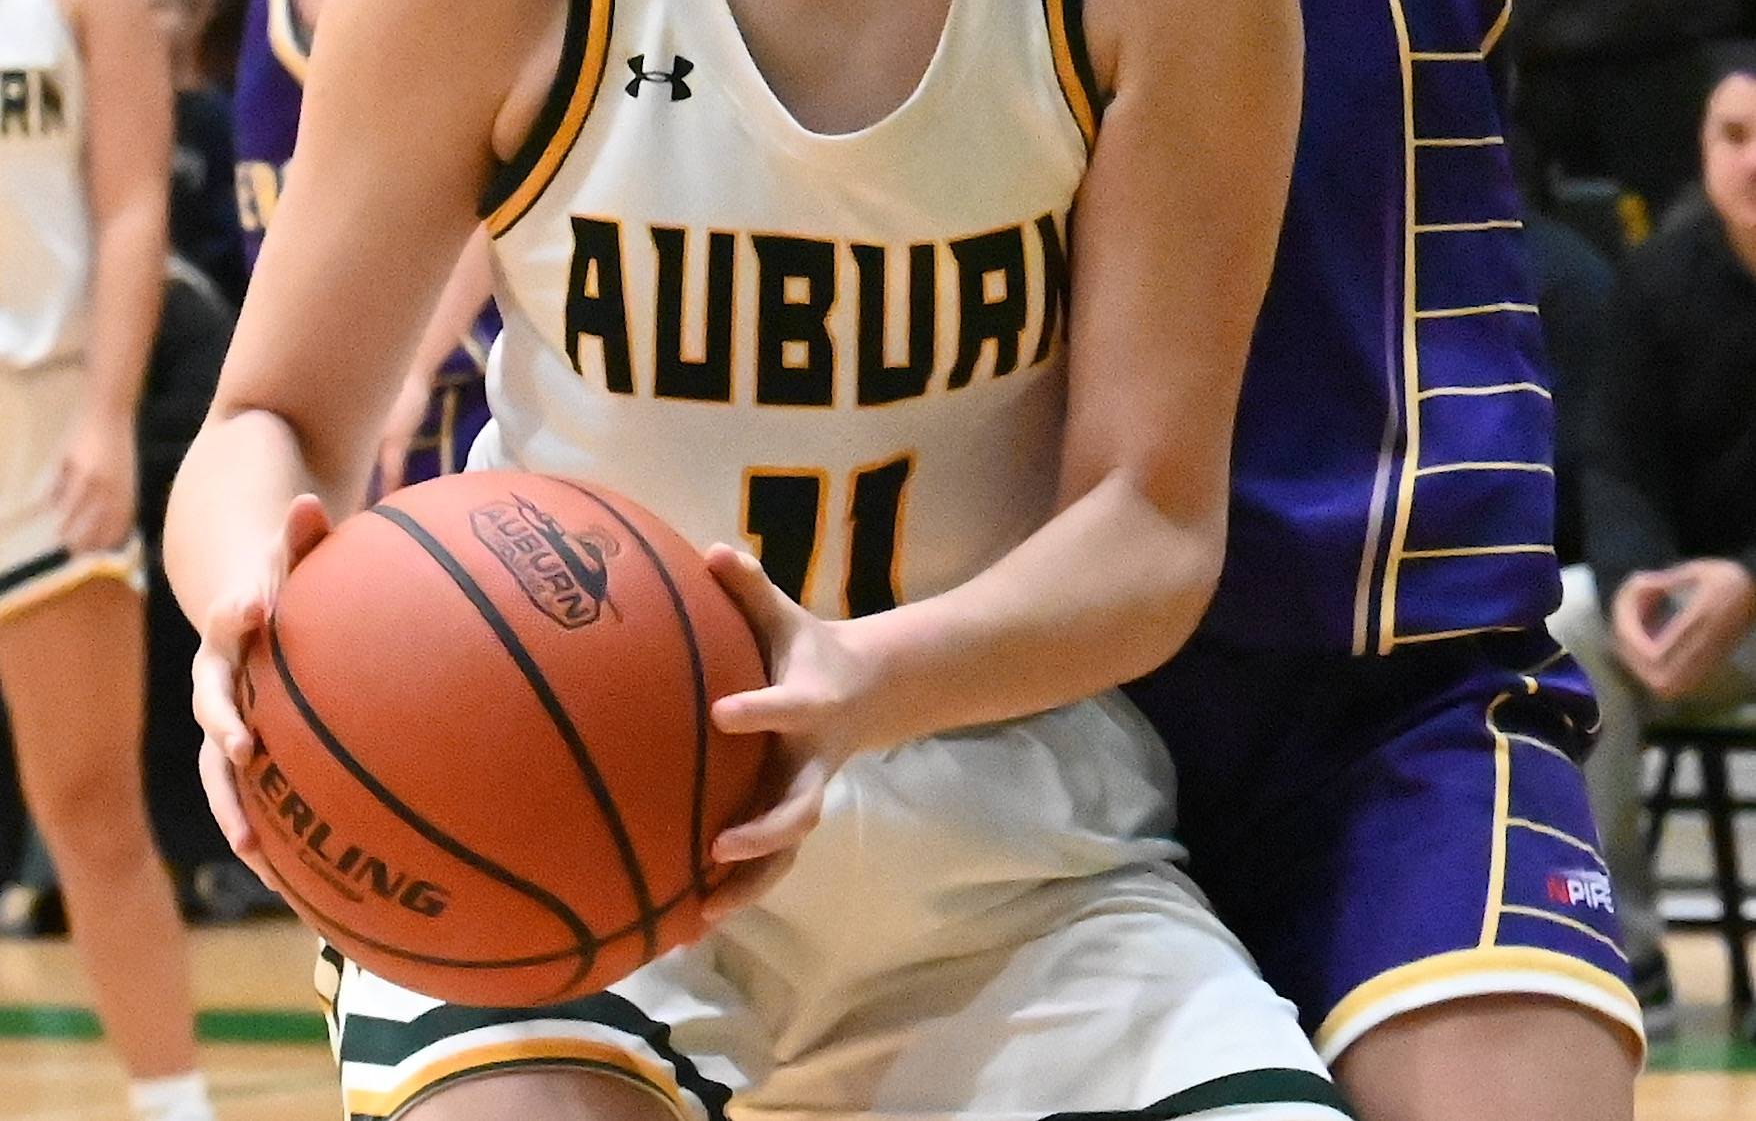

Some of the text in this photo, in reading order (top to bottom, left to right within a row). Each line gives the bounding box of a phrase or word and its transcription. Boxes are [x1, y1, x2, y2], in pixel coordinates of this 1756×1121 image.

[564, 214, 1070, 408] AUBURN
[479, 508, 592, 620] AUBURN
[742, 451, 914, 619] 11
[253, 728, 450, 918] ERLING
